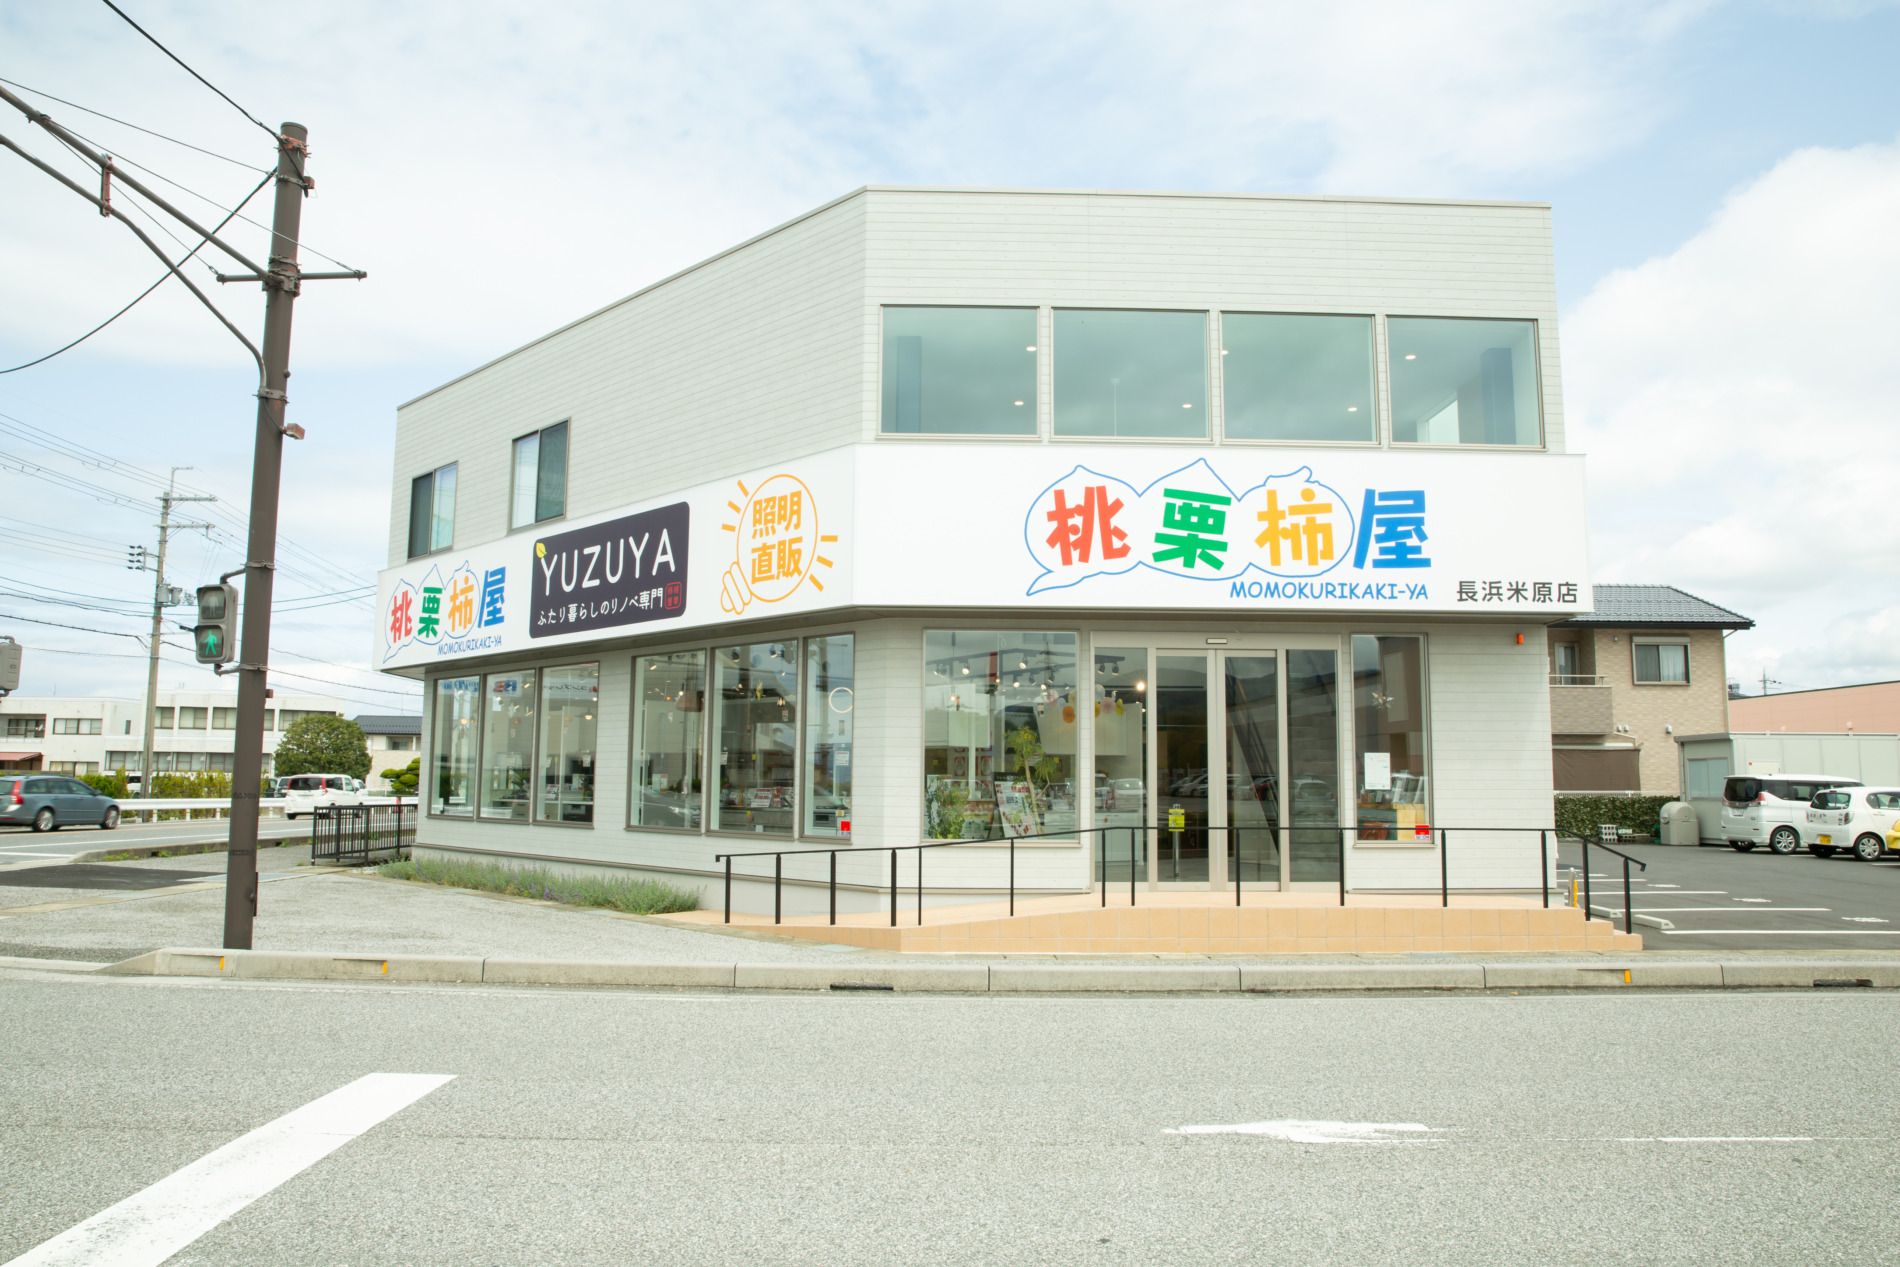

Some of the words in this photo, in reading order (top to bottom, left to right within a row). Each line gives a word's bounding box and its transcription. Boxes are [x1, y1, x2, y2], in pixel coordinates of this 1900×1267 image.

[751, 490, 802, 539] 照明
[1045, 485, 1432, 571] 桃栗柿屋
[540, 527, 676, 597] YUZUYA
[751, 536, 803, 584] 直販
[390, 566, 506, 643] 桃栗柿屋
[537, 587, 664, 626] ふたり暮らしのリノベ専門
[1230, 581, 1429, 600] MOMOKURIKAKI-YA
[1456, 580, 1579, 603] 長浜米原店
[437, 635, 503, 656] MOMOKURIKAKI-YA
